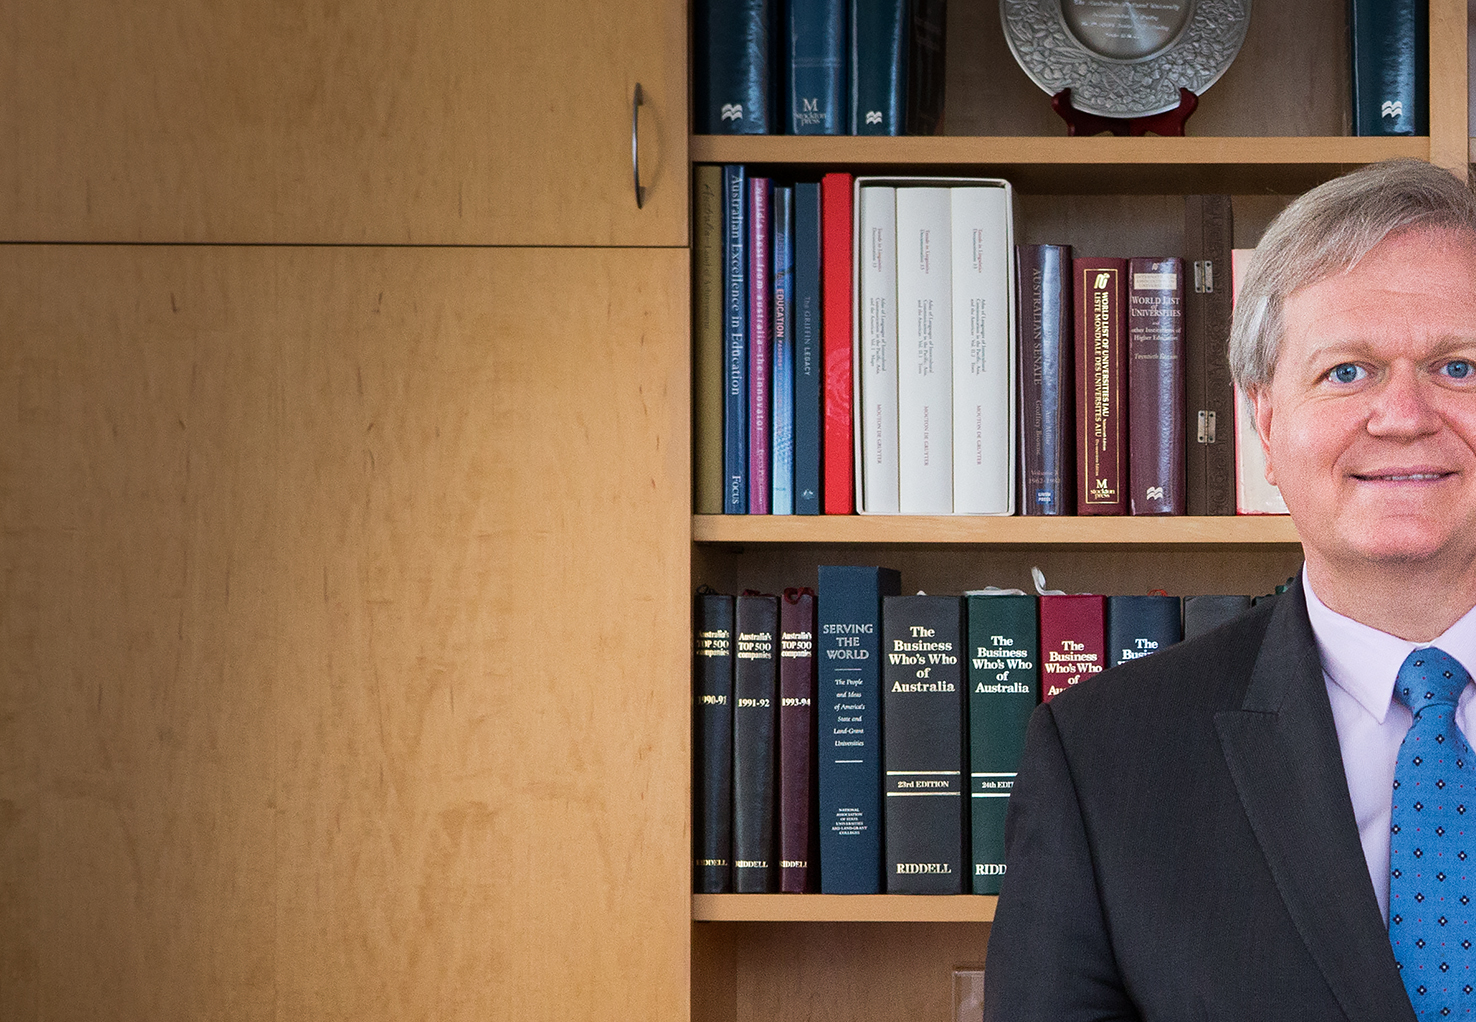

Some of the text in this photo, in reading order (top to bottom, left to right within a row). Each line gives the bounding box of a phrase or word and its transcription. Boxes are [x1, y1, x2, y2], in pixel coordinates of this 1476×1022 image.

[732, 175, 743, 395] Australian Excellence in Education
[1132, 296, 1180, 304] WORLD LIST
[776, 288, 784, 338] EDUCATION
[1131, 308, 1181, 317] UNIVERSITIES
[1032, 268, 1042, 386] AUSTRALIAN SENATE
[1094, 313, 1102, 356] MONDIALE
[1102, 339, 1109, 349] OF
[1094, 356, 1102, 372] DES
[1094, 374, 1102, 422] UNIVERSITES
[1102, 403, 1110, 417] IAU
[823, 624, 873, 634] SERVING
[910, 626, 936, 638] The
[738, 632, 772, 640] Australia's
[782, 632, 812, 640] Australia's
[990, 636, 1014, 646] The
[738, 642, 771, 651] TOP 500
[781, 641, 812, 650] TOP 500
[836, 636, 860, 647] THE
[893, 640, 952, 651] Business
[1062, 640, 1084, 651] The
[1134, 638, 1159, 649] The
[738, 651, 772, 661] companies
[781, 650, 812, 659] companies
[826, 650, 869, 660] WORLD
[976, 647, 1028, 658] Business
[1050, 652, 1098, 662] Business
[888, 654, 958, 665] Who's Who
[972, 658, 1032, 670] Who's Who
[916, 668, 932, 678] of
[1044, 662, 1103, 674] Who's Who
[996, 671, 1010, 681] of
[1068, 674, 1080, 684] of
[891, 680, 956, 692] Australia
[974, 682, 1030, 693] Australia
[738, 698, 770, 708] 1991-92
[782, 698, 810, 706] 1993-94
[898, 780, 950, 788] 23rd EDITION
[735, 860, 768, 868] RIDDELL
[896, 863, 952, 874] RIDDELL
[975, 864, 1007, 875] RIDD
